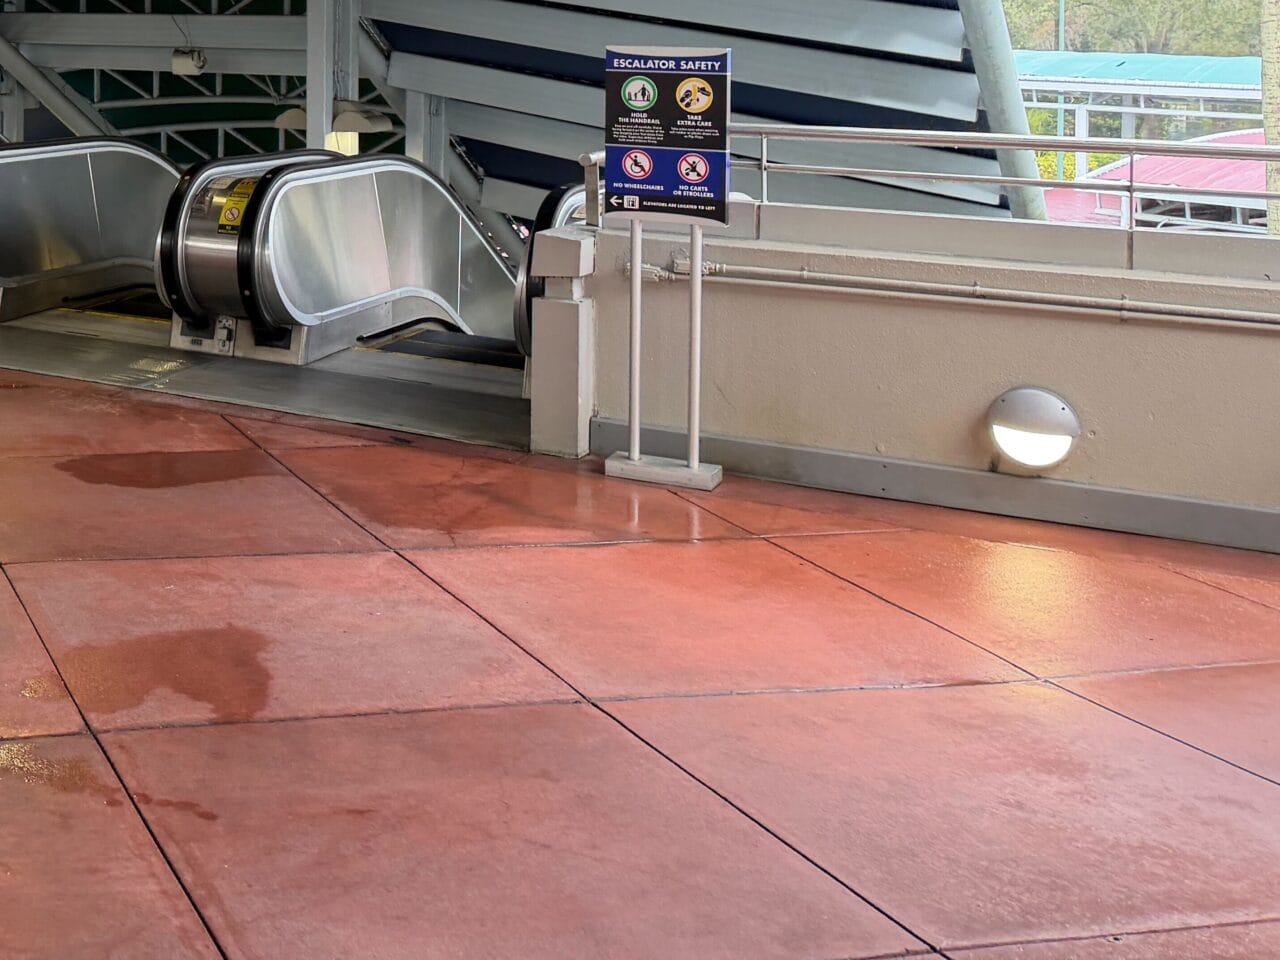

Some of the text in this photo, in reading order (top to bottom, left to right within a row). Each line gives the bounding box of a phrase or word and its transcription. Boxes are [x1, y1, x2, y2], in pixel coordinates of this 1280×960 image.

[613, 58, 721, 71] ESCALATOR SAFETY
[630, 117, 660, 125] HANDRAIL
[624, 183, 664, 191] WHEELCHAIRS
